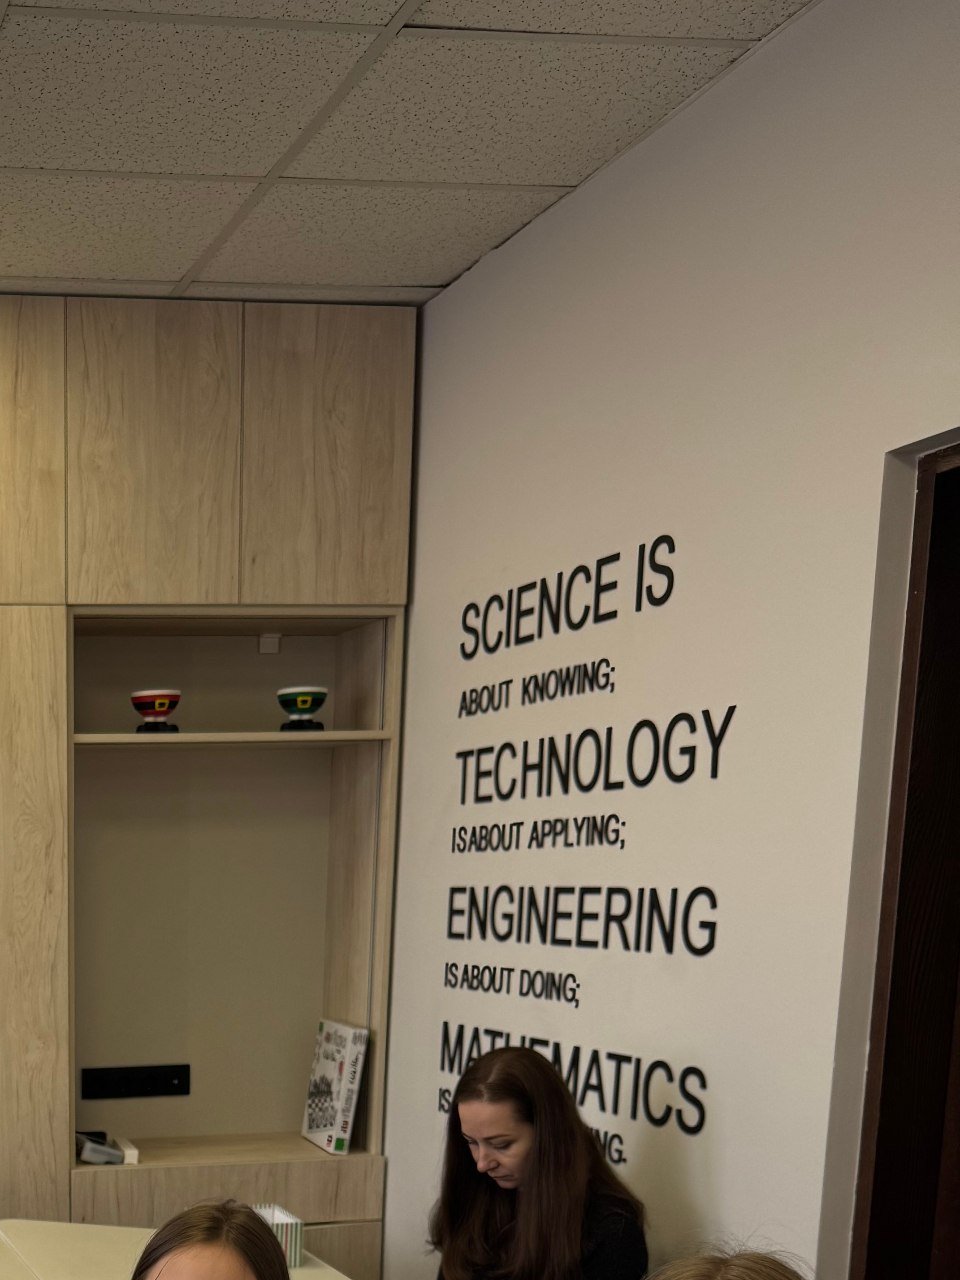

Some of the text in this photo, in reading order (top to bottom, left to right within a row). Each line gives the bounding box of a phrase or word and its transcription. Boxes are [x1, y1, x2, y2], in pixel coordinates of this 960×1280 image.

[459, 534, 676, 661] SCIENCE IS
[458, 658, 616, 719] ABOUT KNOWING;
[456, 705, 737, 806] TECHNOLOGY
[527, 813, 626, 849] APPLYING;
[447, 885, 718, 957] ENGINEERING
[460, 964, 515, 995] ABOUT
[519, 969, 581, 1008] DOING;
